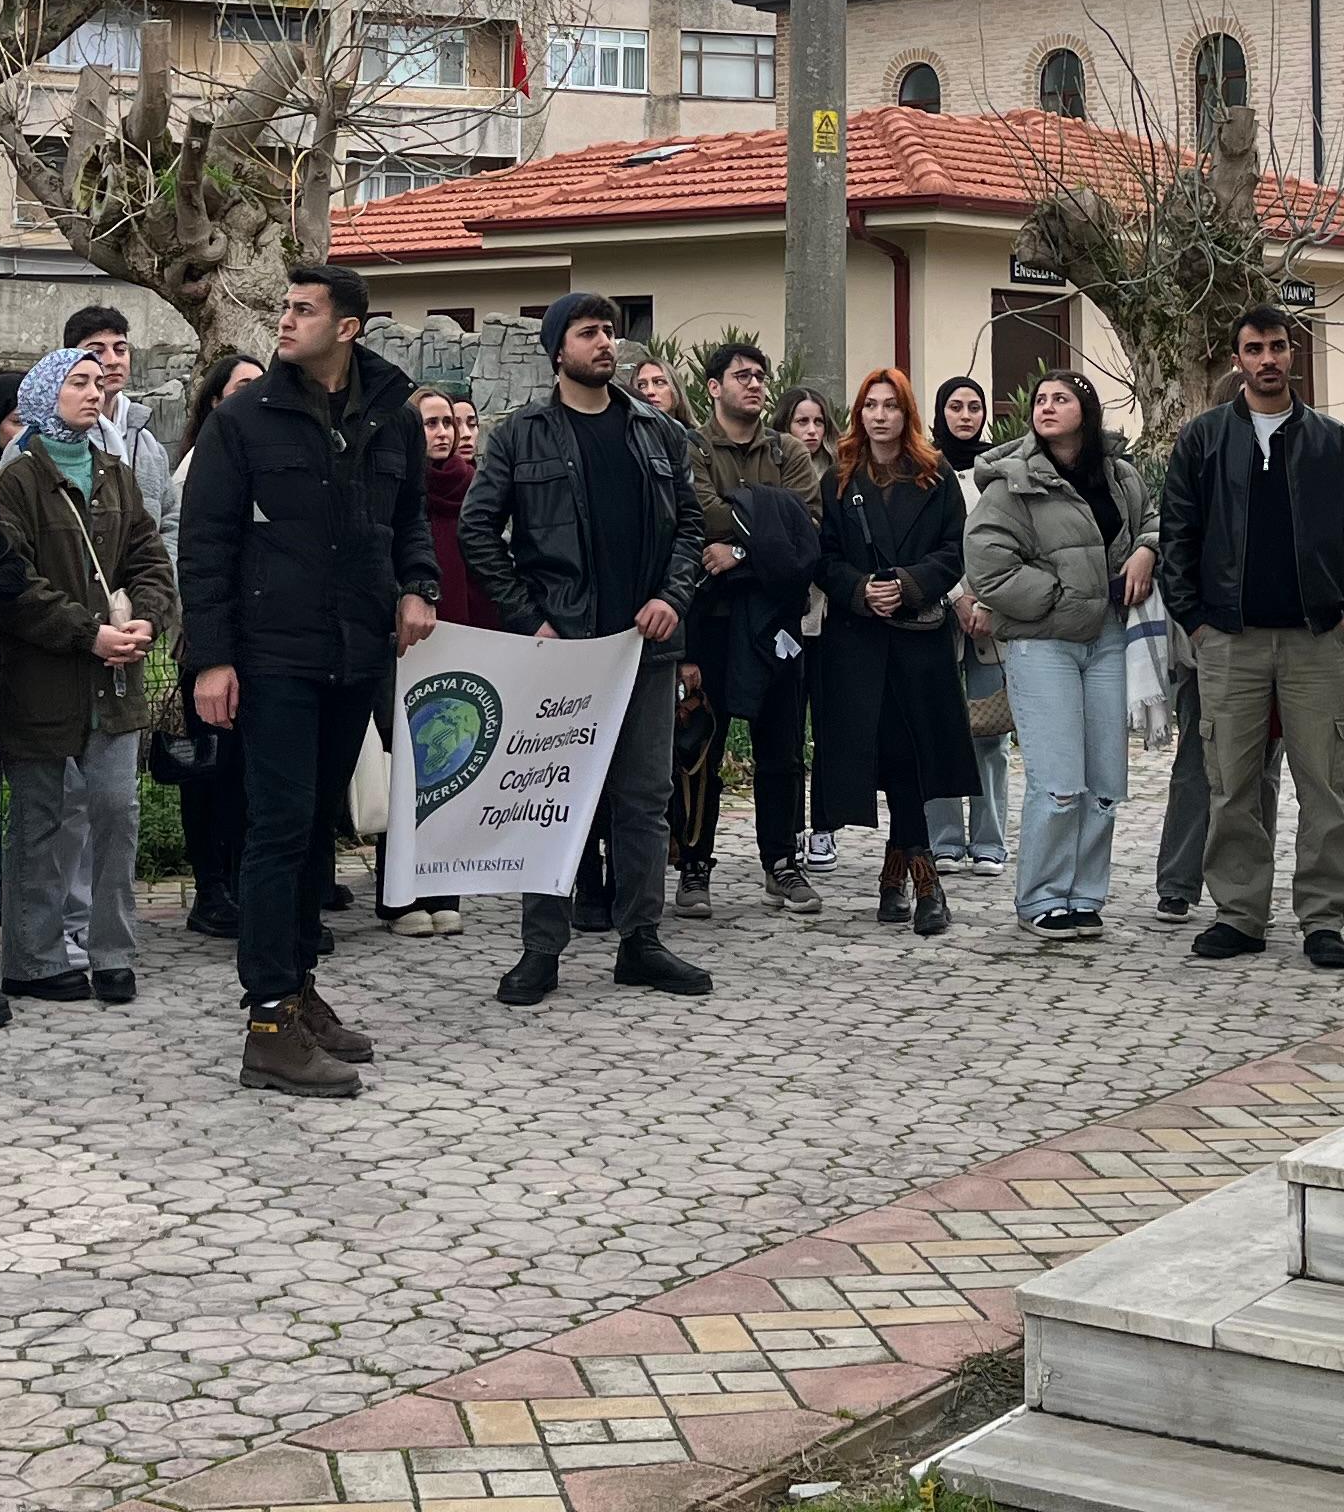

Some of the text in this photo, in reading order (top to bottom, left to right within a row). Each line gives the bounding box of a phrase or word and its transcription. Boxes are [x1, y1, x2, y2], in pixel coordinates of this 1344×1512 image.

[1301, 287, 1313, 301] WC
[536, 695, 592, 718] Sakarya
[506, 722, 597, 755] Üniversitesi
[500, 762, 570, 793] Coğrafya
[479, 798, 569, 830] Topluluğu
